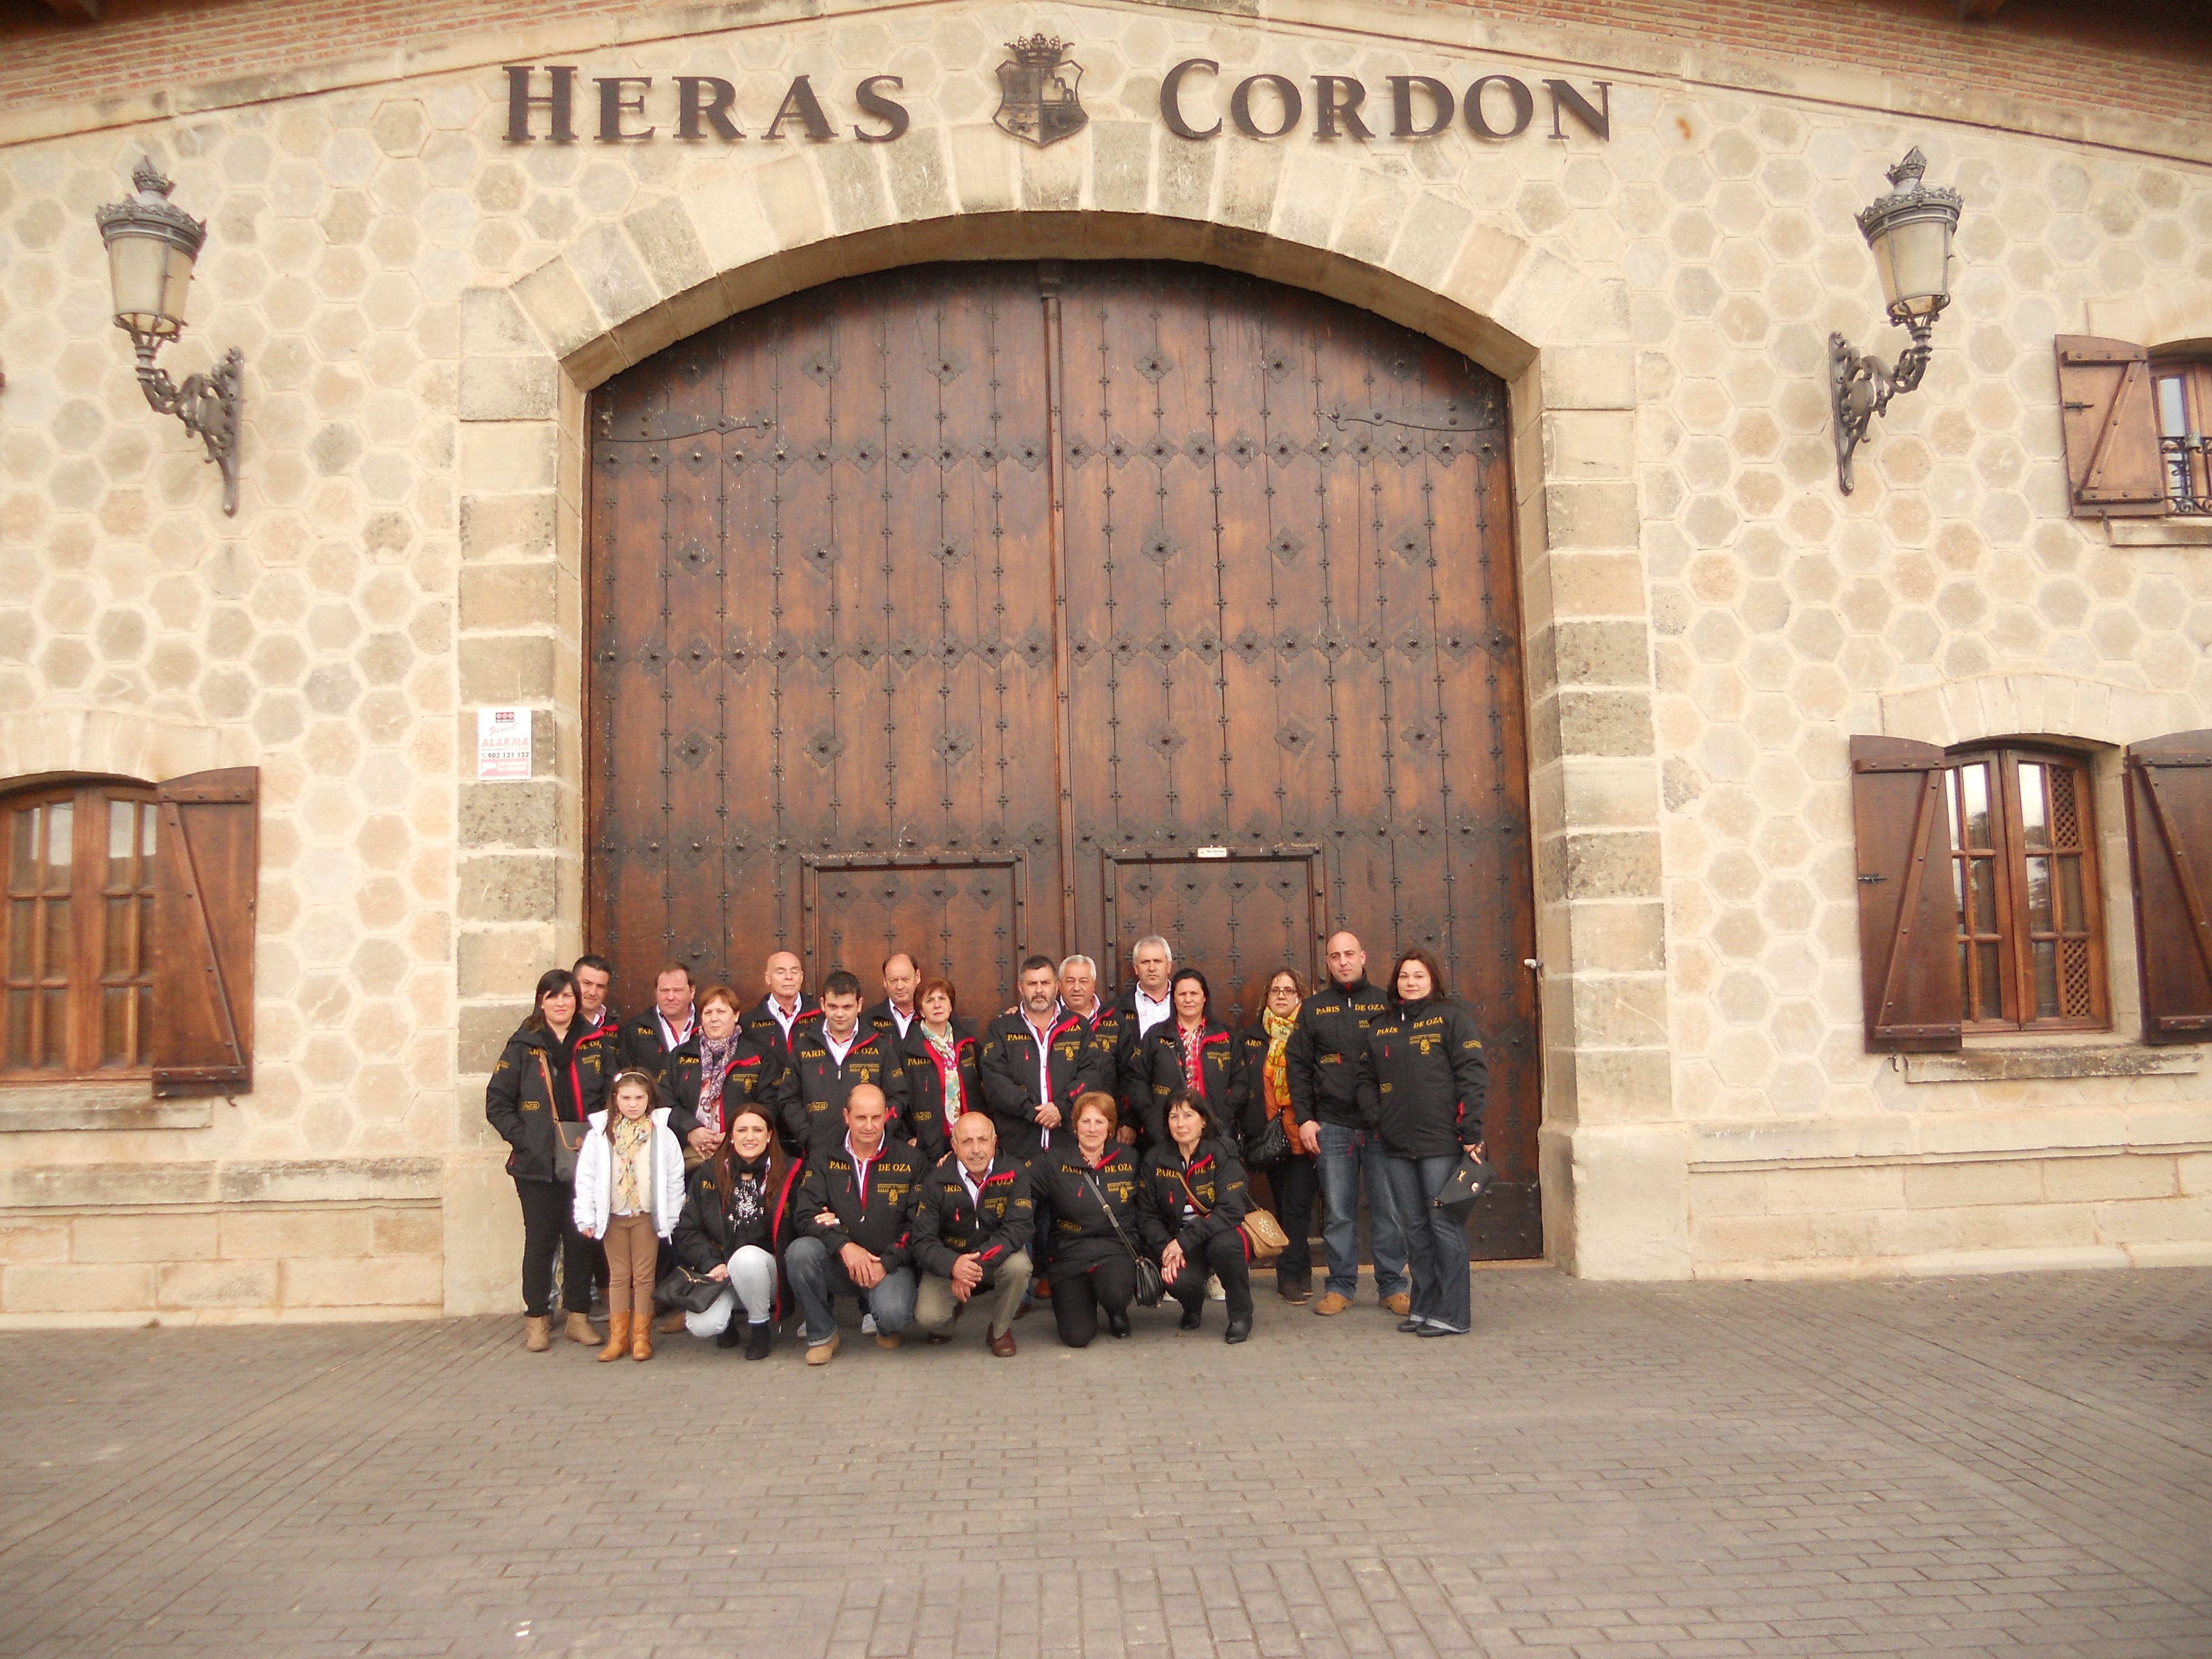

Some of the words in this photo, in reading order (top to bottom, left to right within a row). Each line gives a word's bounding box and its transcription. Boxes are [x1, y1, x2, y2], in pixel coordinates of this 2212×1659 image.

[502, 65, 910, 143] HERAS
[1160, 58, 1613, 142] CORDON
[489, 722, 519, 736] Direct
[482, 737, 529, 747] ALARMA
[1316, 1005, 1340, 1015] PARIS
[1426, 1016, 1444, 1025] OZA
[801, 1050, 826, 1058] PARIS
[878, 1164, 891, 1172] DE
[893, 1164, 911, 1172] OZA
[1118, 1163, 1133, 1171] OZA
[1156, 1168, 1180, 1178] PARIS
[1194, 1166, 1206, 1174] DE
